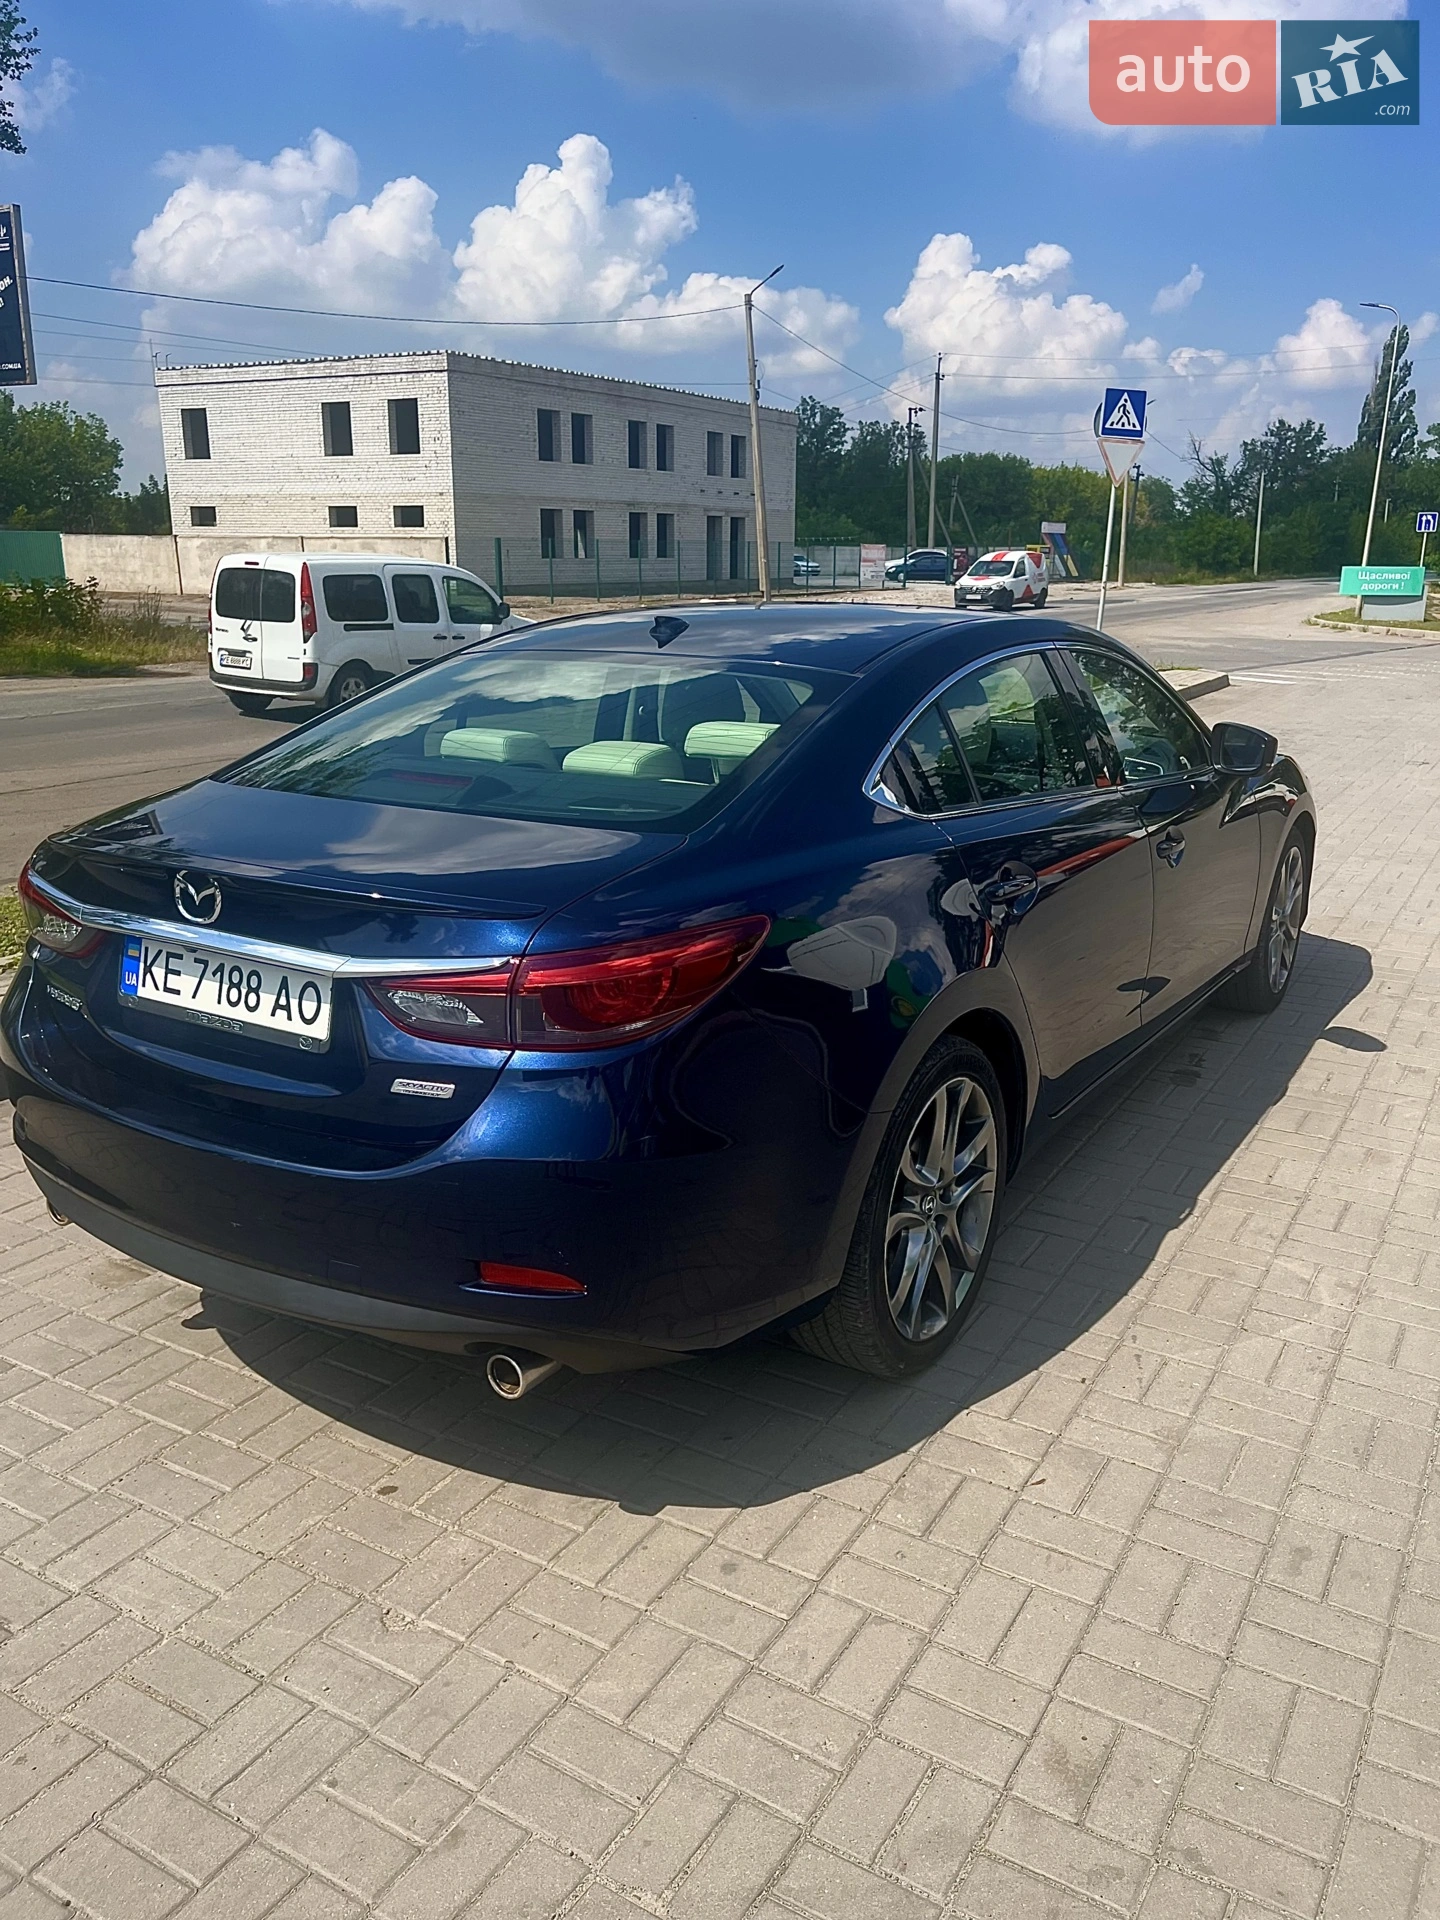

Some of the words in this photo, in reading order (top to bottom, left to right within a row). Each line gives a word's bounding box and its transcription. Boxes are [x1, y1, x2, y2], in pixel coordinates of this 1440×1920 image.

[1358, 571, 1411, 581] Щасливої
[125, 971, 137, 986] UA
[142, 946, 184, 995] KE
[191, 958, 262, 1013] 7188
[270, 975, 322, 1026] AO
[397, 1081, 452, 1093] SKYACTIV
